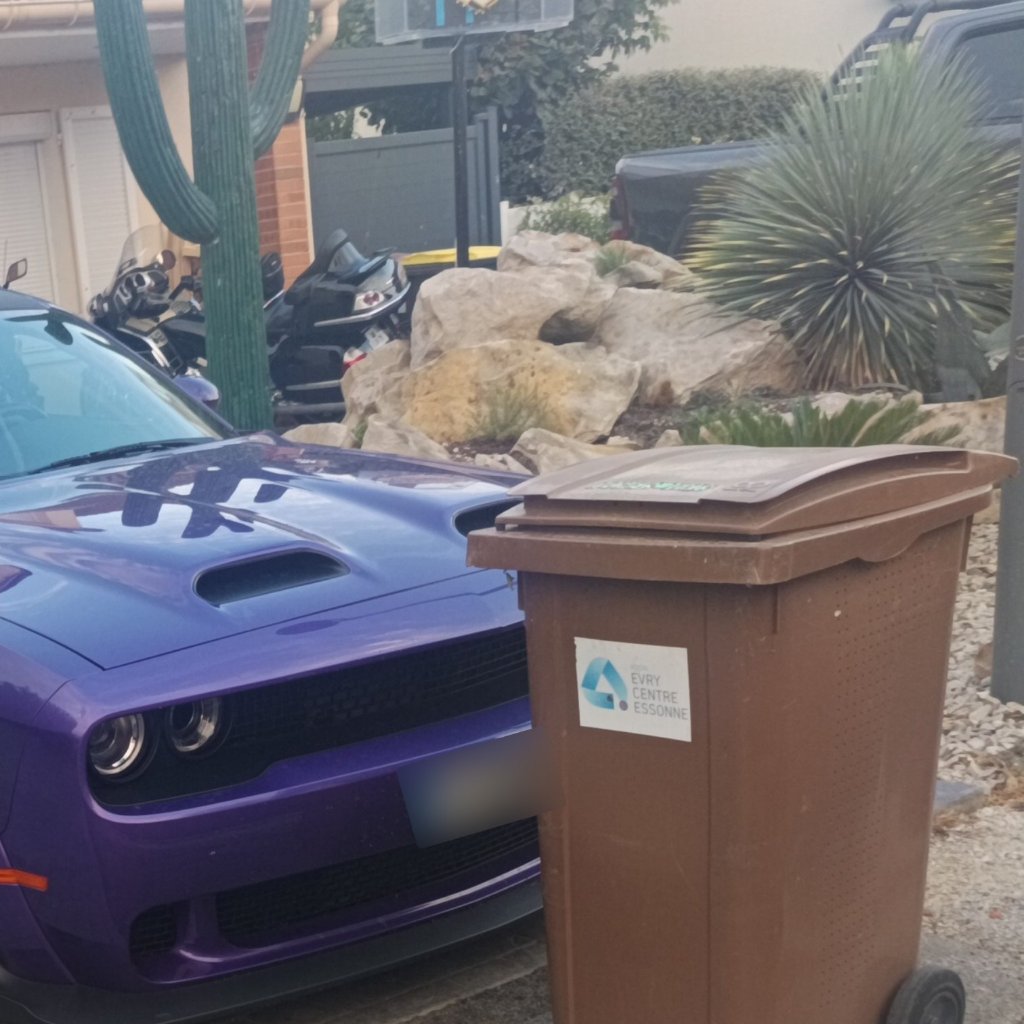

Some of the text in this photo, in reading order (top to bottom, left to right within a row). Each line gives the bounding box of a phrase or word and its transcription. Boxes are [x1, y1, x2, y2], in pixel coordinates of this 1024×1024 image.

[631, 672, 661, 687] EVRY
[632, 687, 678, 704] CENTRE
[634, 702, 689, 720] ESSONNE
